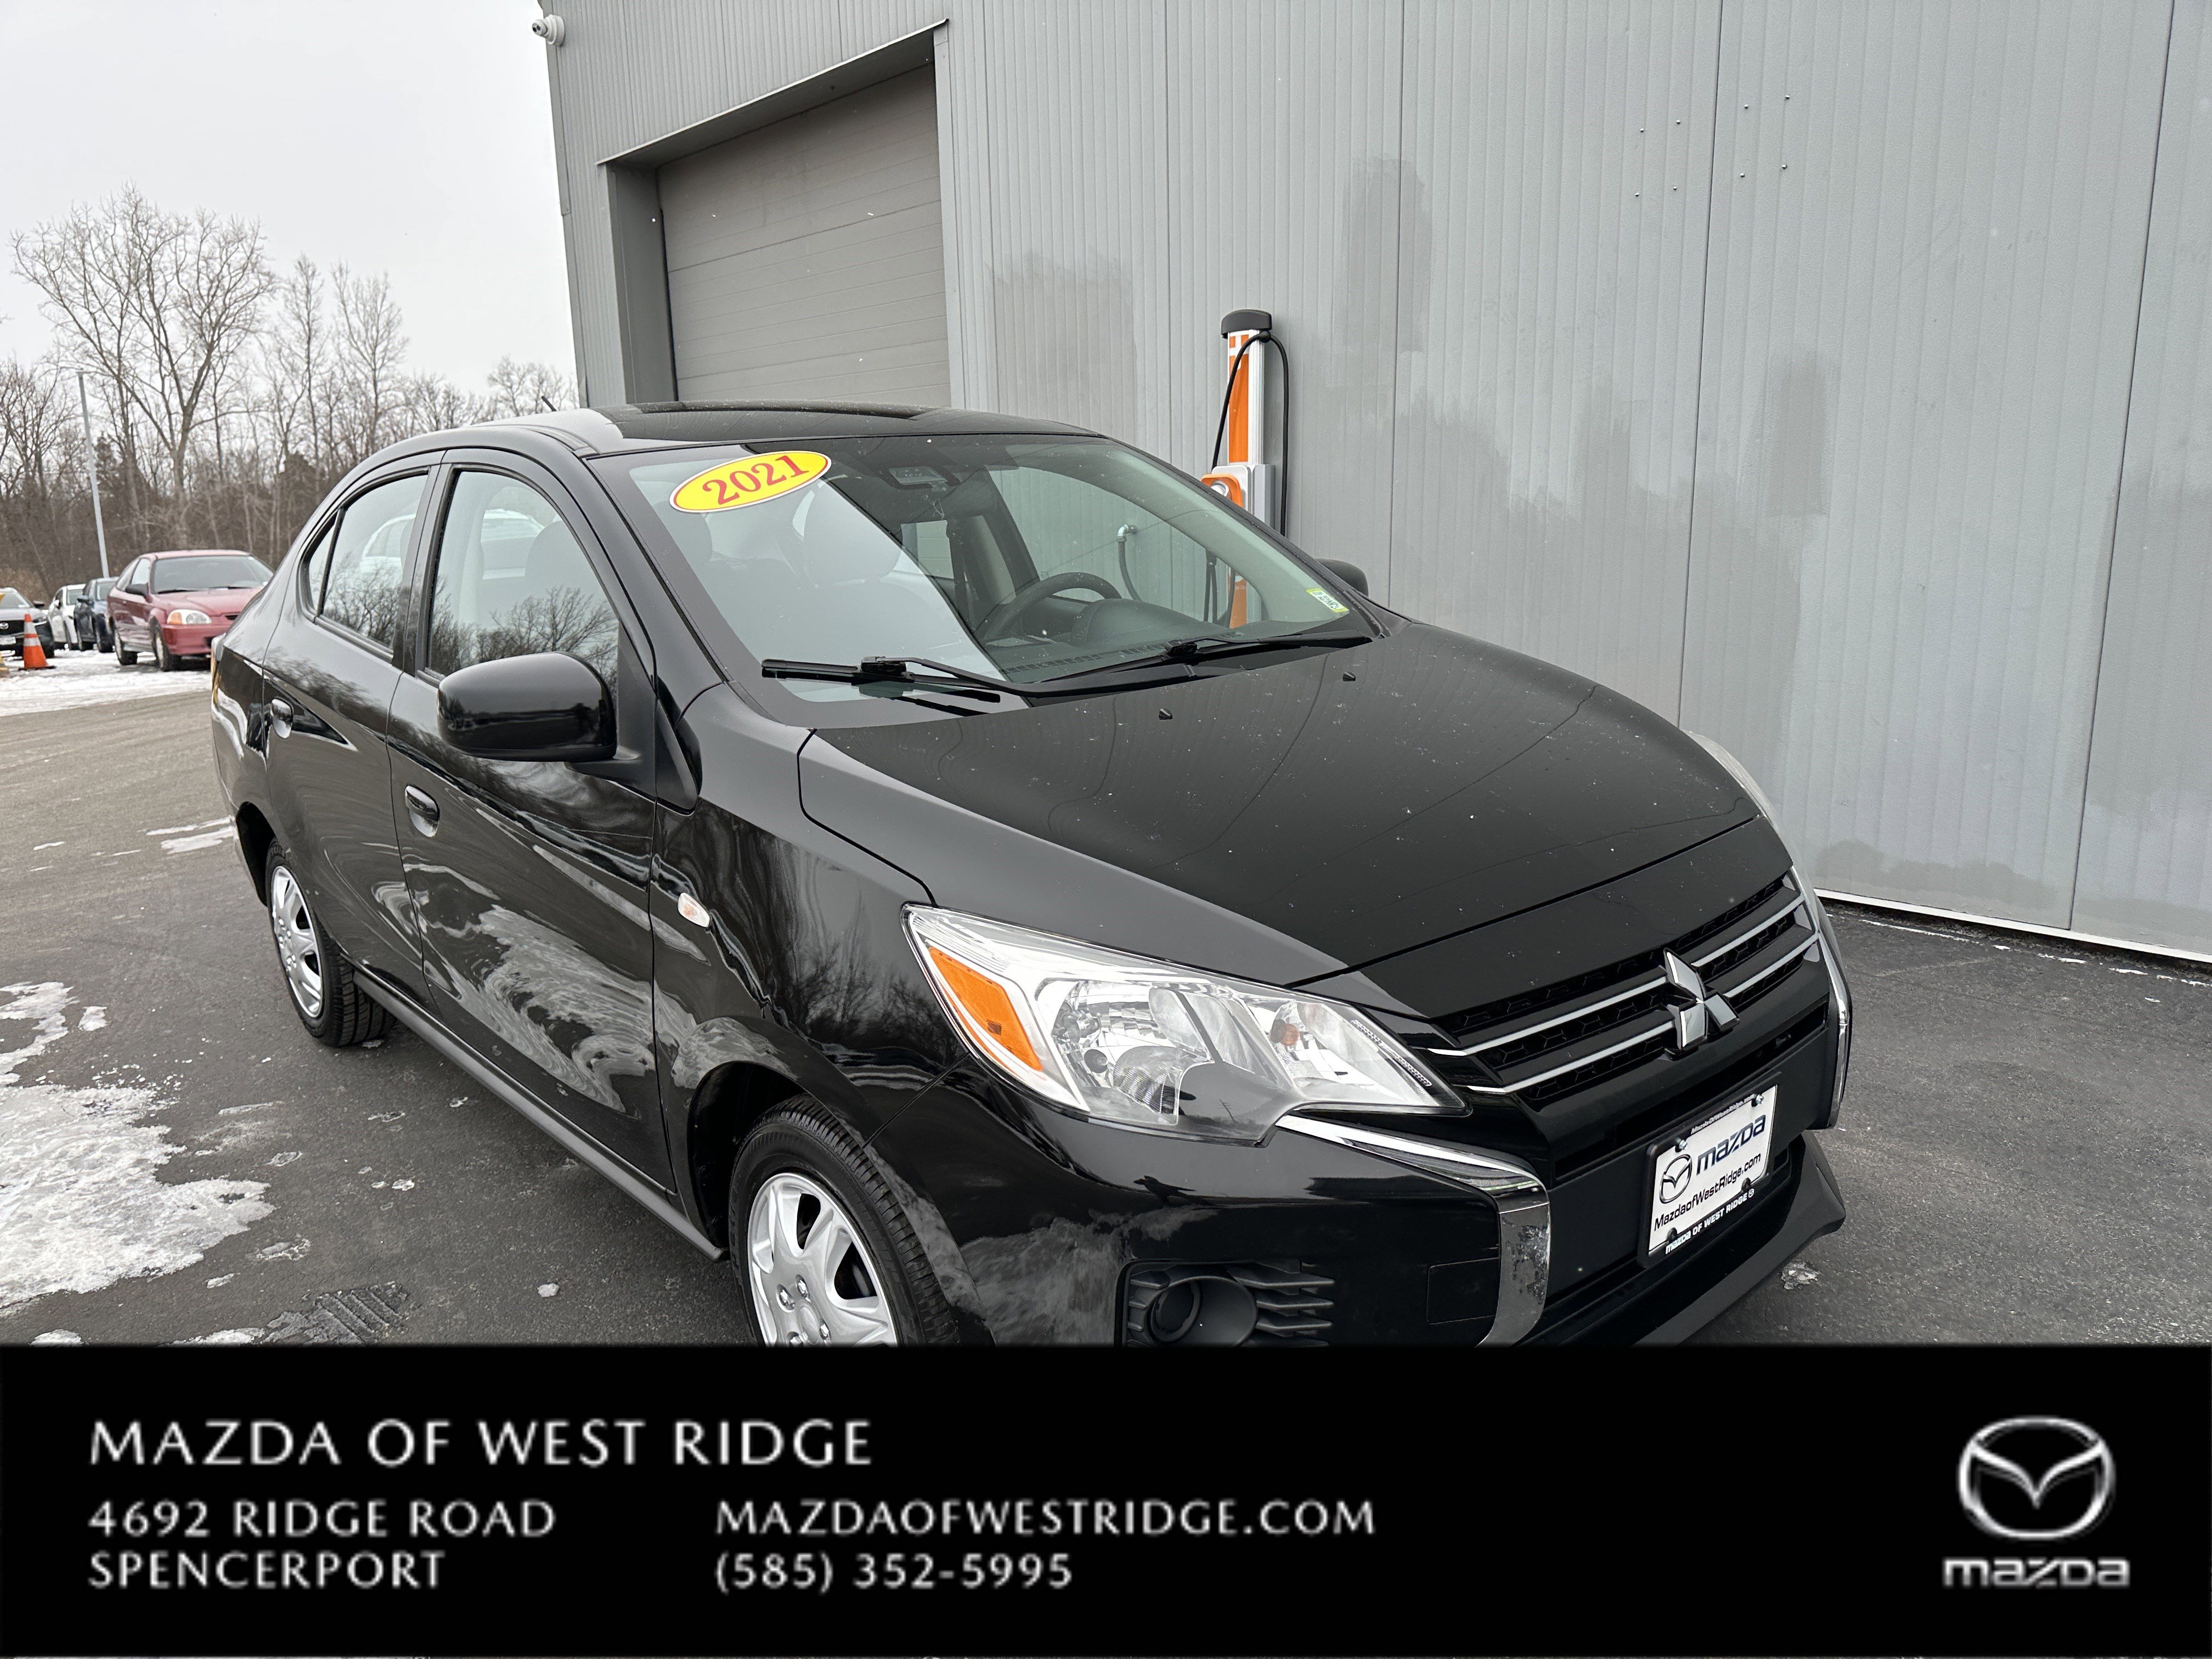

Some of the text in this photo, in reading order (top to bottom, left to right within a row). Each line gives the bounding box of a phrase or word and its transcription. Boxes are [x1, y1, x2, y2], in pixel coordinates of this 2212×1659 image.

[702, 455, 810, 505] 2021
[1654, 1154, 1761, 1232] MazdaofWestRidge.com
[1692, 1223, 1702, 1236] OF
[1704, 1207, 1724, 1228] WEST
[1726, 1193, 1747, 1214] RIDGE
